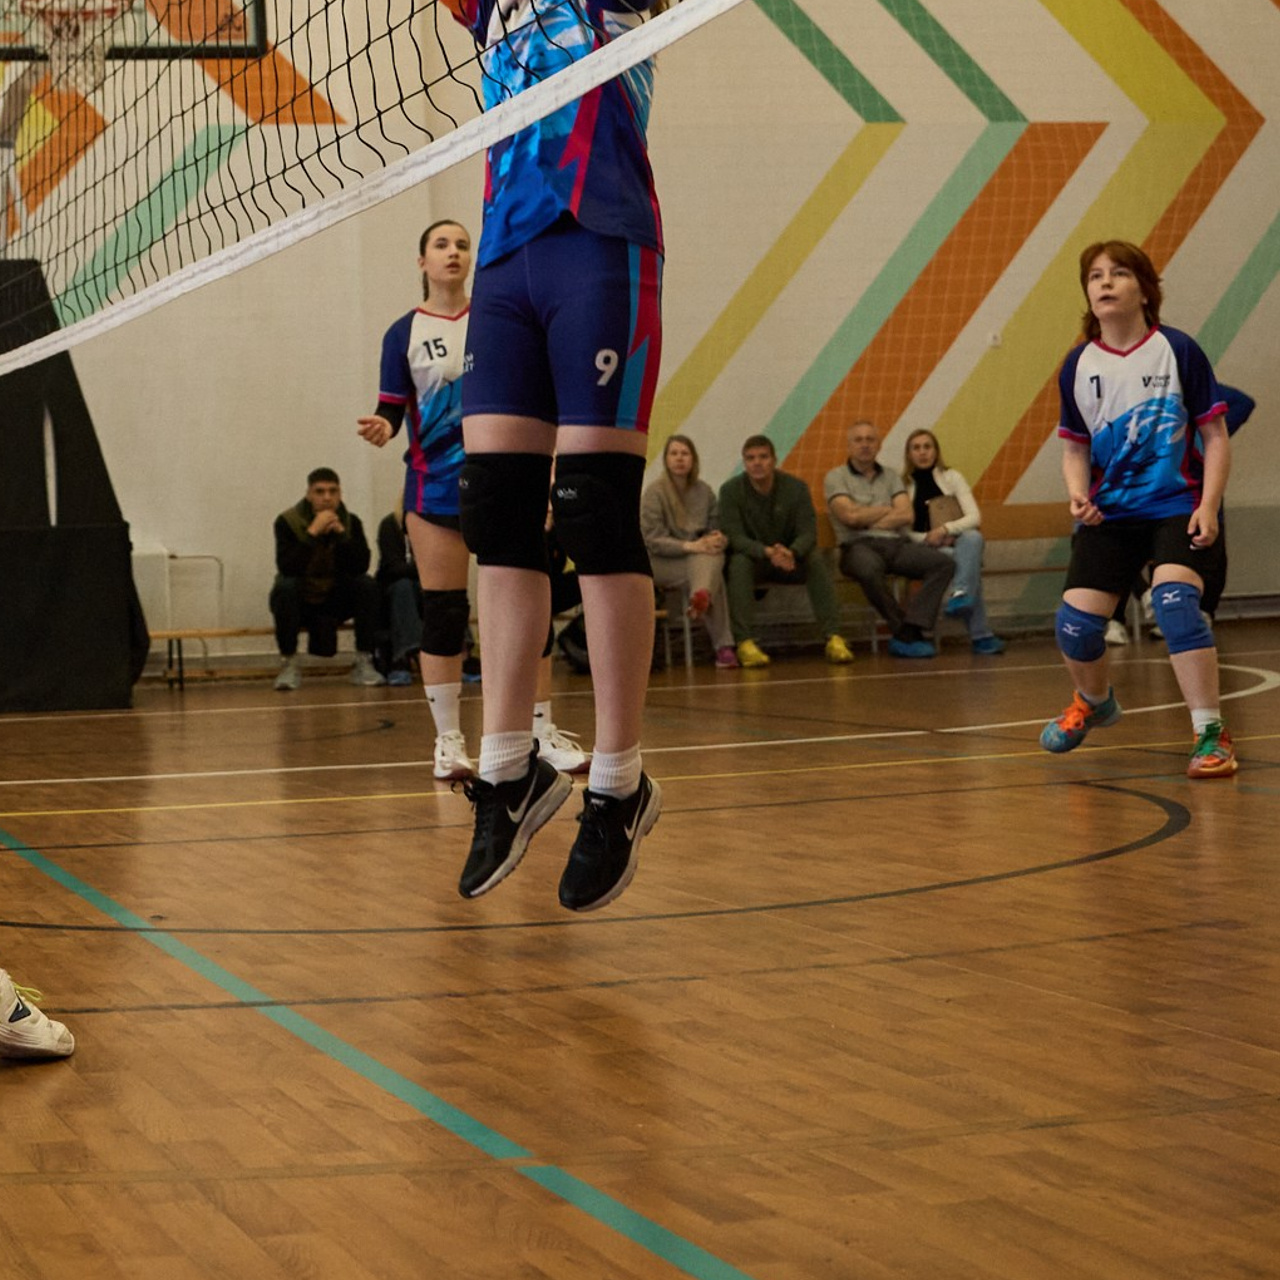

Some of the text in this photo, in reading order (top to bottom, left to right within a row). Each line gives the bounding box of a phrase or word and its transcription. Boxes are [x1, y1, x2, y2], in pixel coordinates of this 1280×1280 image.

[422, 337, 448, 361] 15
[595, 349, 619, 386] 9
[1089, 374, 1102, 399] 7
